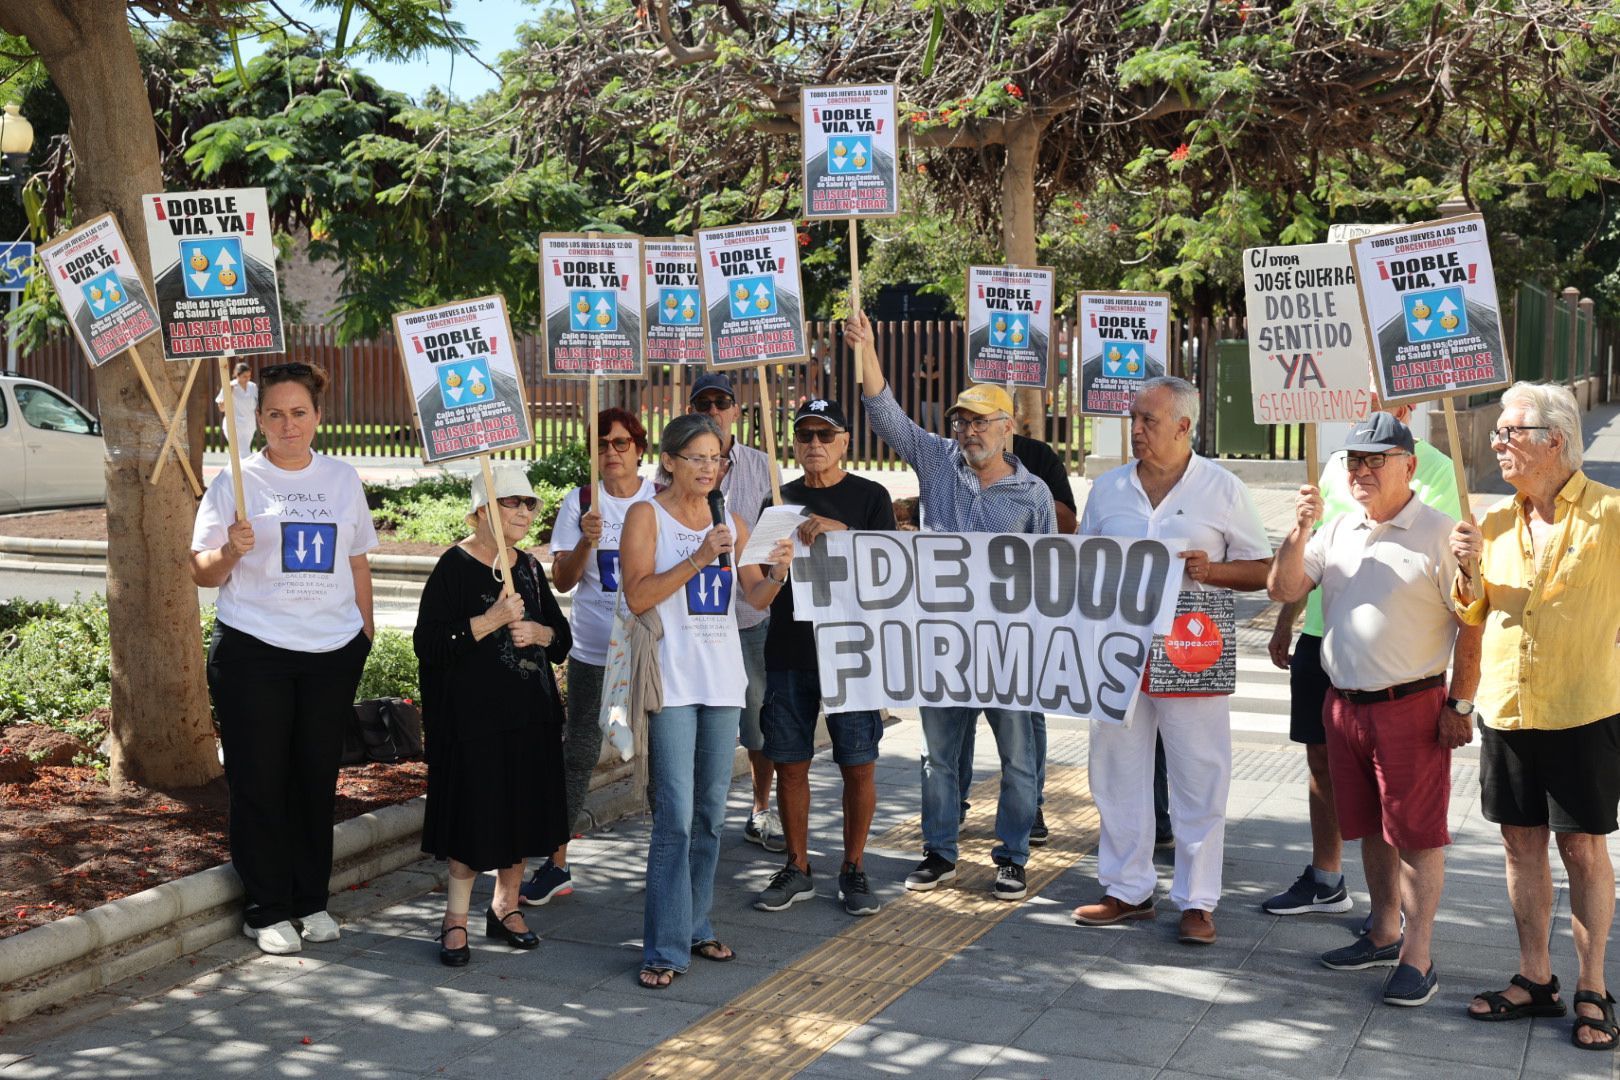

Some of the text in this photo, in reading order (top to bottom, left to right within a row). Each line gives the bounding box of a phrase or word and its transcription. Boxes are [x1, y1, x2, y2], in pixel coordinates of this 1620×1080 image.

[812, 108, 871, 123] ¡DOBLE
[857, 119, 884, 134] YA!
[153, 196, 237, 221] ¡DOBLE
[217, 212, 254, 235] YA!
[1371, 238, 1394, 248] TODOS
[1395, 235, 1409, 244] LOS
[1409, 232, 1435, 242] JUEVES
[1457, 224, 1478, 234] 12:00
[56, 244, 107, 280] ¡DOBLE
[97, 249, 121, 270] YA!
[553, 259, 616, 275] ¡DOBLE
[709, 247, 772, 267] ¡DOBLE
[756, 258, 785, 273] YA!
[1251, 249, 1299, 268] C/ DTOR
[1376, 251, 1459, 280] ¡DOBLE
[600, 274, 629, 290] YA!
[1254, 266, 1356, 291] JOSÉ GUERRA
[1439, 264, 1477, 284] YA!
[978, 285, 1030, 299] ¡DOBLE
[173, 311, 185, 319] de
[186, 309, 210, 318] Salud
[217, 308, 228, 316] de
[229, 306, 265, 316] Mayores
[176, 301, 198, 310] Calle
[199, 300, 210, 309] de
[225, 297, 259, 307] Centros
[406, 316, 426, 325] TODOS
[438, 309, 460, 319] JUEVES
[478, 302, 495, 311] 12:00
[1017, 300, 1041, 314] YA!
[1265, 291, 1336, 320] DOBLE
[169, 317, 271, 337] LA ISLETA NO SE
[1090, 313, 1146, 328] ¡DOBLE
[171, 333, 273, 354] DEJA ENCERRAR
[411, 326, 482, 353] ¡DOBLE
[717, 329, 795, 348] LA ISLETA NO SE
[1131, 329, 1157, 343] YA!
[1258, 318, 1352, 352] SENTIDO
[1398, 345, 1420, 354] Calle
[1420, 343, 1431, 351] de
[1447, 336, 1481, 347] Centros
[466, 337, 497, 355] YA!
[555, 348, 633, 358] LA ISLETA NO SE
[718, 341, 796, 360] DEJA ENCERRAR
[1407, 350, 1431, 360] Salud
[1451, 343, 1488, 354] Mayores
[555, 360, 633, 370] DEJA ENCERRAR
[1391, 351, 1493, 378] LA ISLETA NO SE
[1393, 365, 1495, 392] DEJA ENCERRAR
[431, 413, 518, 442] LA ISLETA NO SE
[434, 426, 520, 455] DEJA ENCERRAR
[852, 532, 974, 613] DE
[988, 536, 1170, 626] 9000
[1168, 640, 1218, 649] agapea.com
[816, 619, 1150, 720] FIRMAS
